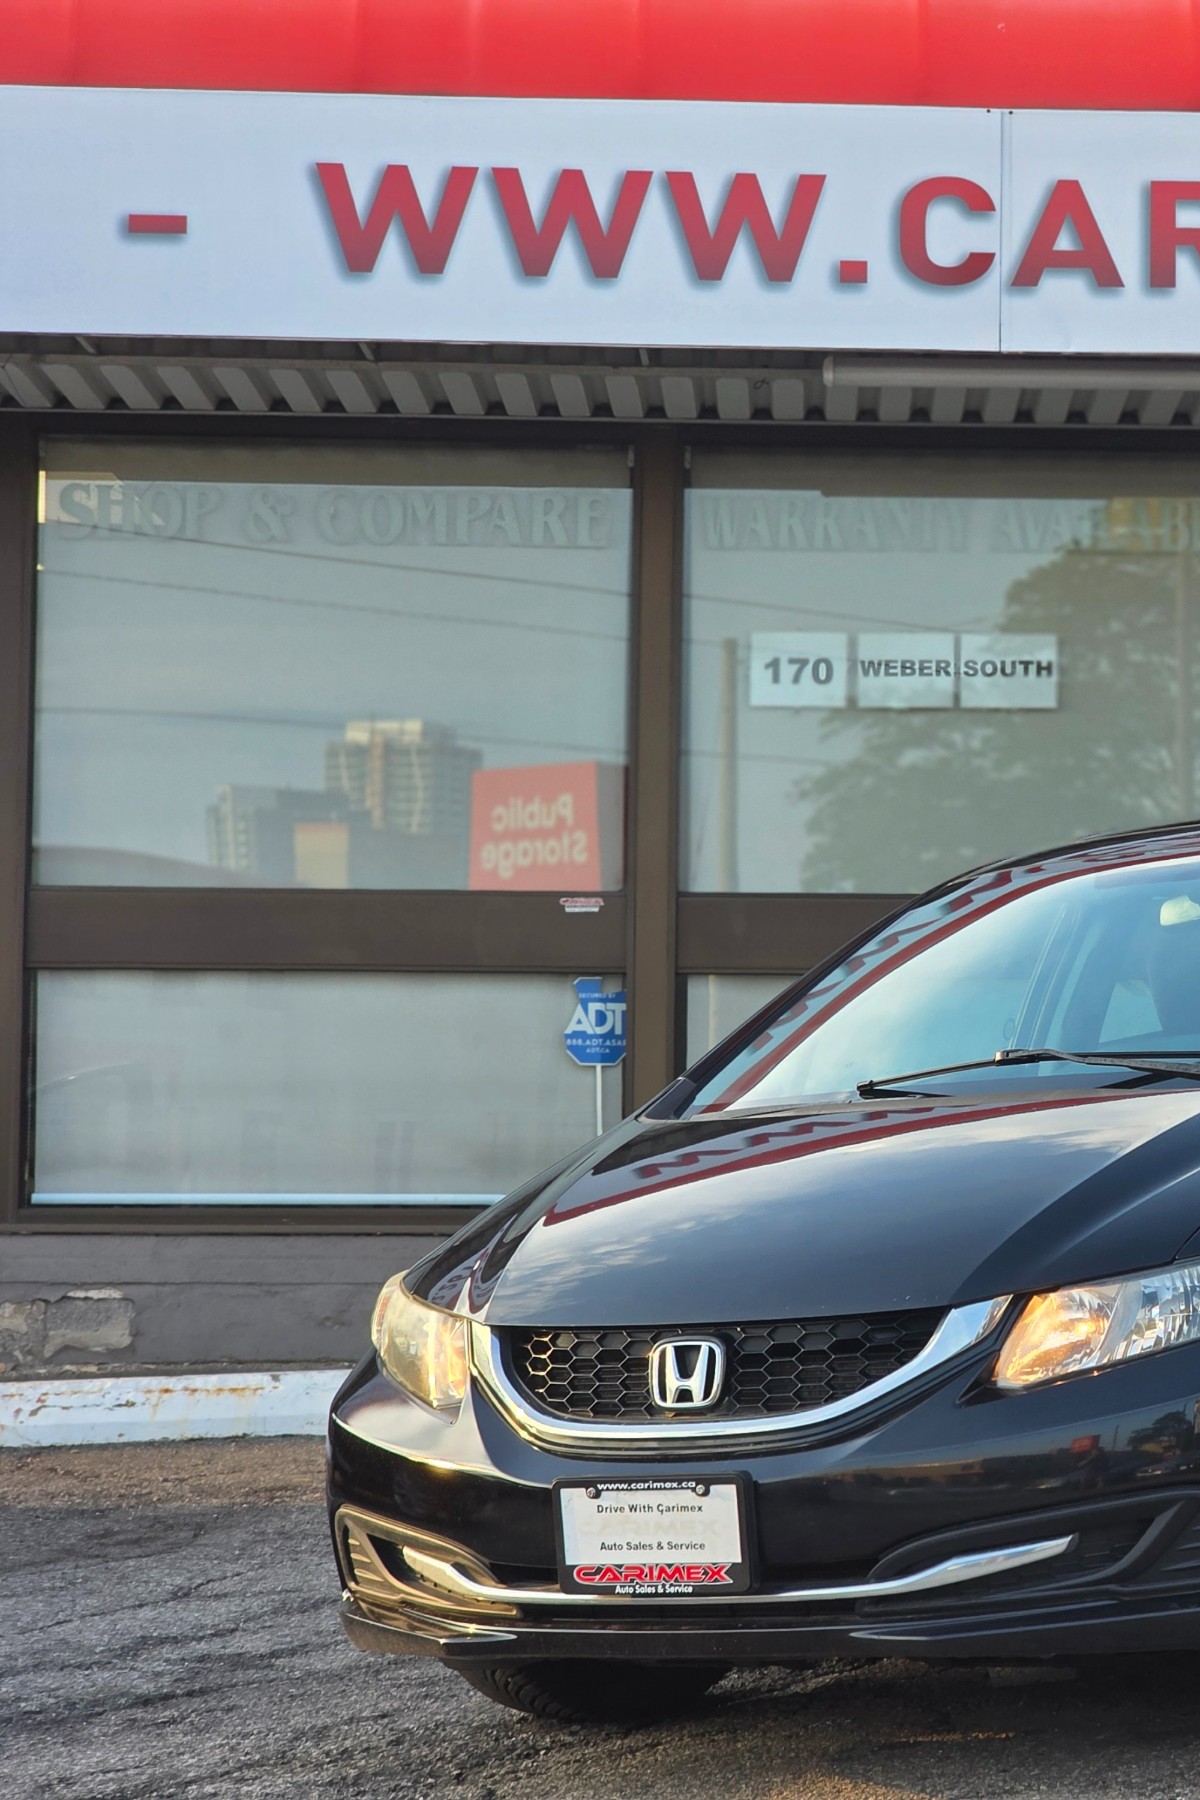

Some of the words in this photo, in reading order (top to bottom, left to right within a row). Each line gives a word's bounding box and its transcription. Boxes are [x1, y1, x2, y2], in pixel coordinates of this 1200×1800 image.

[57, 481, 223, 542] SHOP
[246, 487, 294, 542] &
[317, 490, 610, 548] COMPARE
[763, 656, 834, 685] 170
[859, 659, 952, 678] WEBER
[963, 659, 1053, 678] SOUTH
[563, 1002, 627, 1035] ADT
[596, 1480, 697, 1491] www.carimex.ca
[596, 1504, 626, 1514] Drive
[628, 1503, 654, 1514] With
[657, 1503, 704, 1515] Carimex
[599, 1541, 624, 1551] Auto
[626, 1541, 653, 1551] Sales
[656, 1541, 664, 1551] &
[667, 1541, 706, 1551] Service
[573, 1563, 734, 1584] CARIMEX
[615, 1584, 635, 1594] Auto
[635, 1584, 656, 1594] Sales
[657, 1584, 664, 1593] &
[665, 1583, 693, 1594] Service
